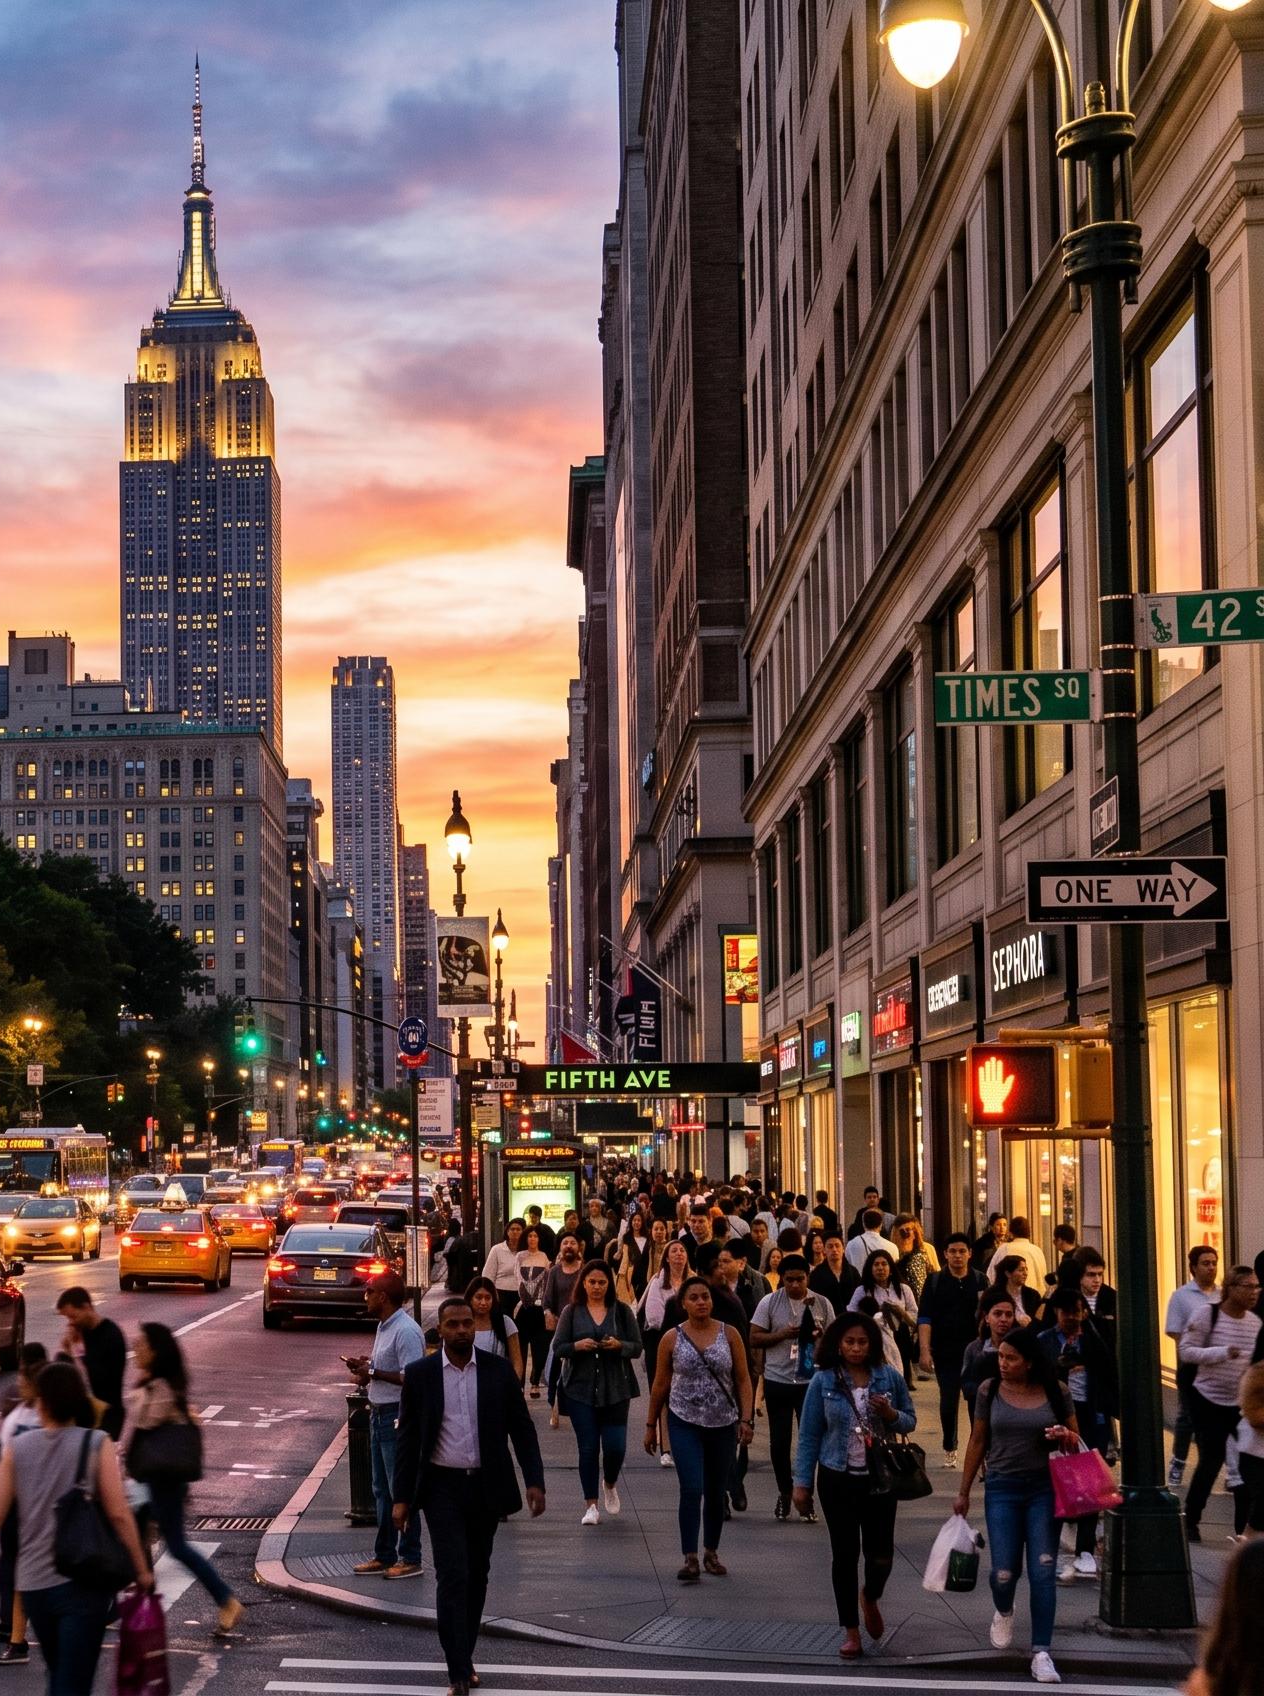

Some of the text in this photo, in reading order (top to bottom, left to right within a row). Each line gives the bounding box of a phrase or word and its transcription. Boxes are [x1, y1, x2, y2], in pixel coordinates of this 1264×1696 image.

[1192, 597, 1242, 637] 42
[944, 677, 1080, 719] TIMES SQ
[1055, 877, 1198, 903] ONE WAY
[992, 931, 1045, 992] SEPHORA
[545, 1070, 671, 1089] FIFTH AVE
